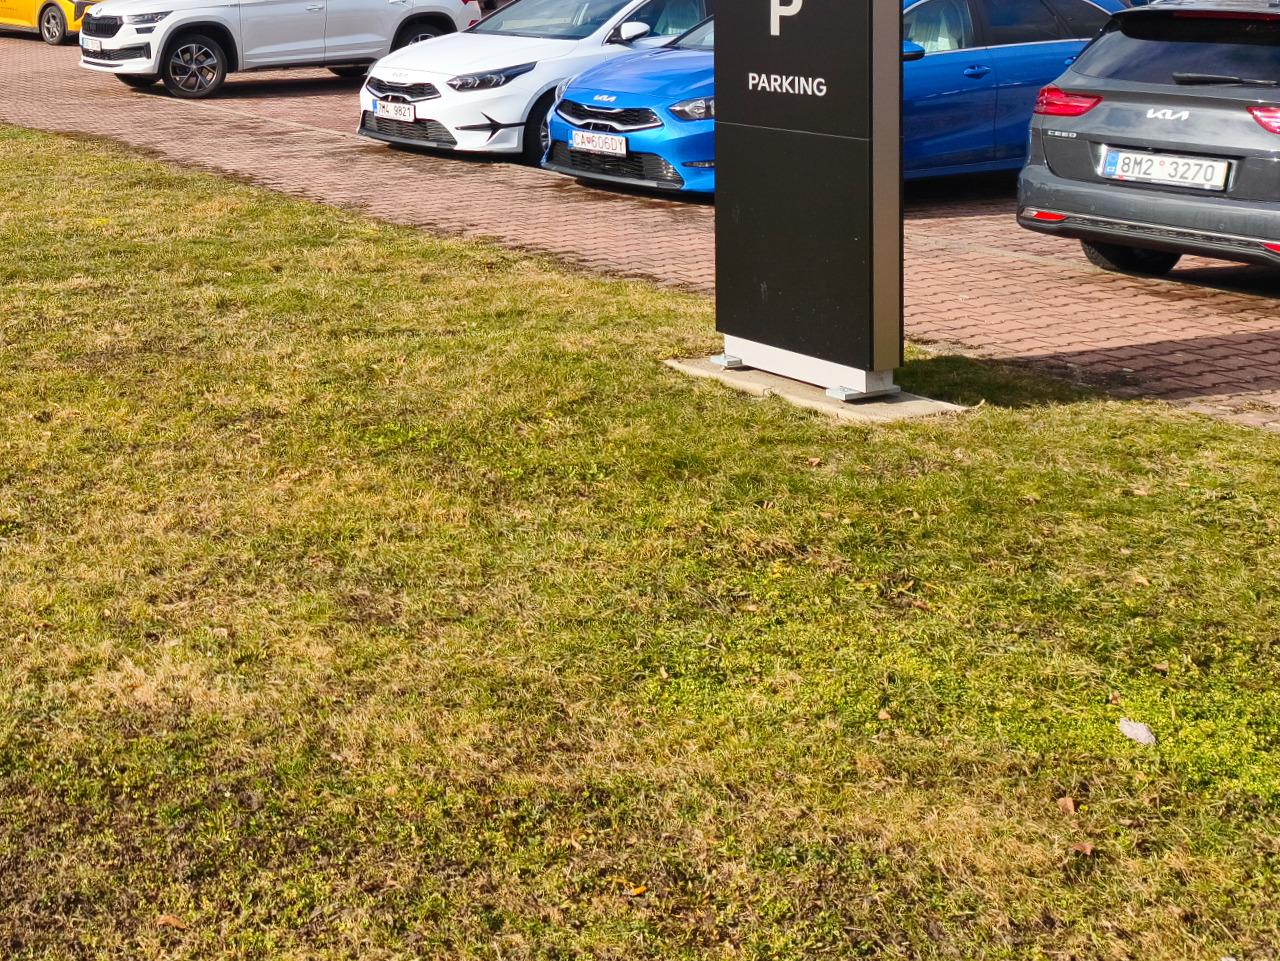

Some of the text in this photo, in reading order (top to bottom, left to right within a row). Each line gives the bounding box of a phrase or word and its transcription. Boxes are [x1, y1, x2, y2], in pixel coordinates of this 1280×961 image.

[748, 72, 827, 96] PARKING
[1146, 108, 1190, 121] KIA
[1048, 130, 1077, 138] CEED
[1121, 155, 1216, 183] 8M2 3270
